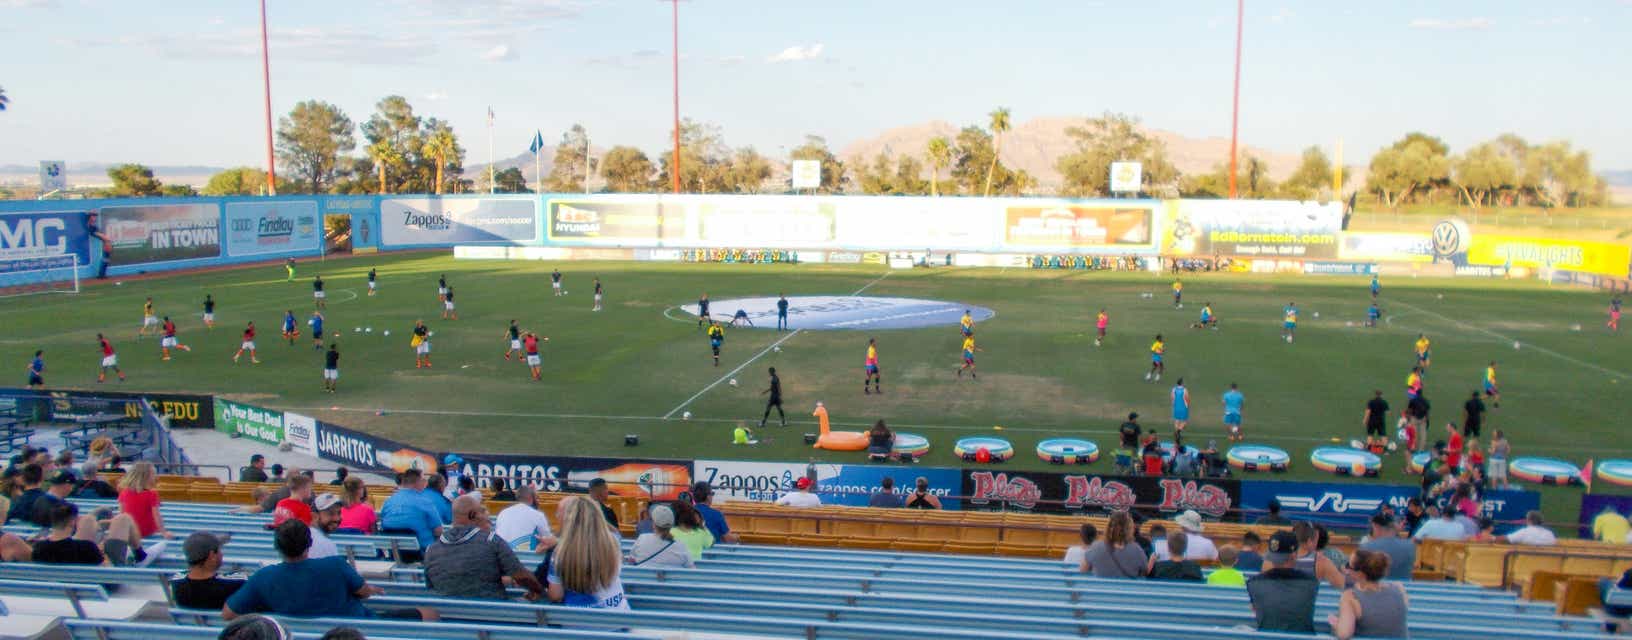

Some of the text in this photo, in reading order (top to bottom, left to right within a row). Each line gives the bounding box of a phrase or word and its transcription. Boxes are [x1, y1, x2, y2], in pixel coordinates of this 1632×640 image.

[258, 217, 294, 233] Findlay
[404, 211, 446, 229] Zappos
[556, 223, 600, 232] HYUNDAI
[152, 231, 169, 249] IN
[171, 228, 218, 247] TOWN
[319, 430, 375, 467] JARRITOS
[462, 463, 562, 492] ARRITOS
[705, 467, 778, 499] Zappos
[816, 482, 950, 498] zappos.cm/scer
